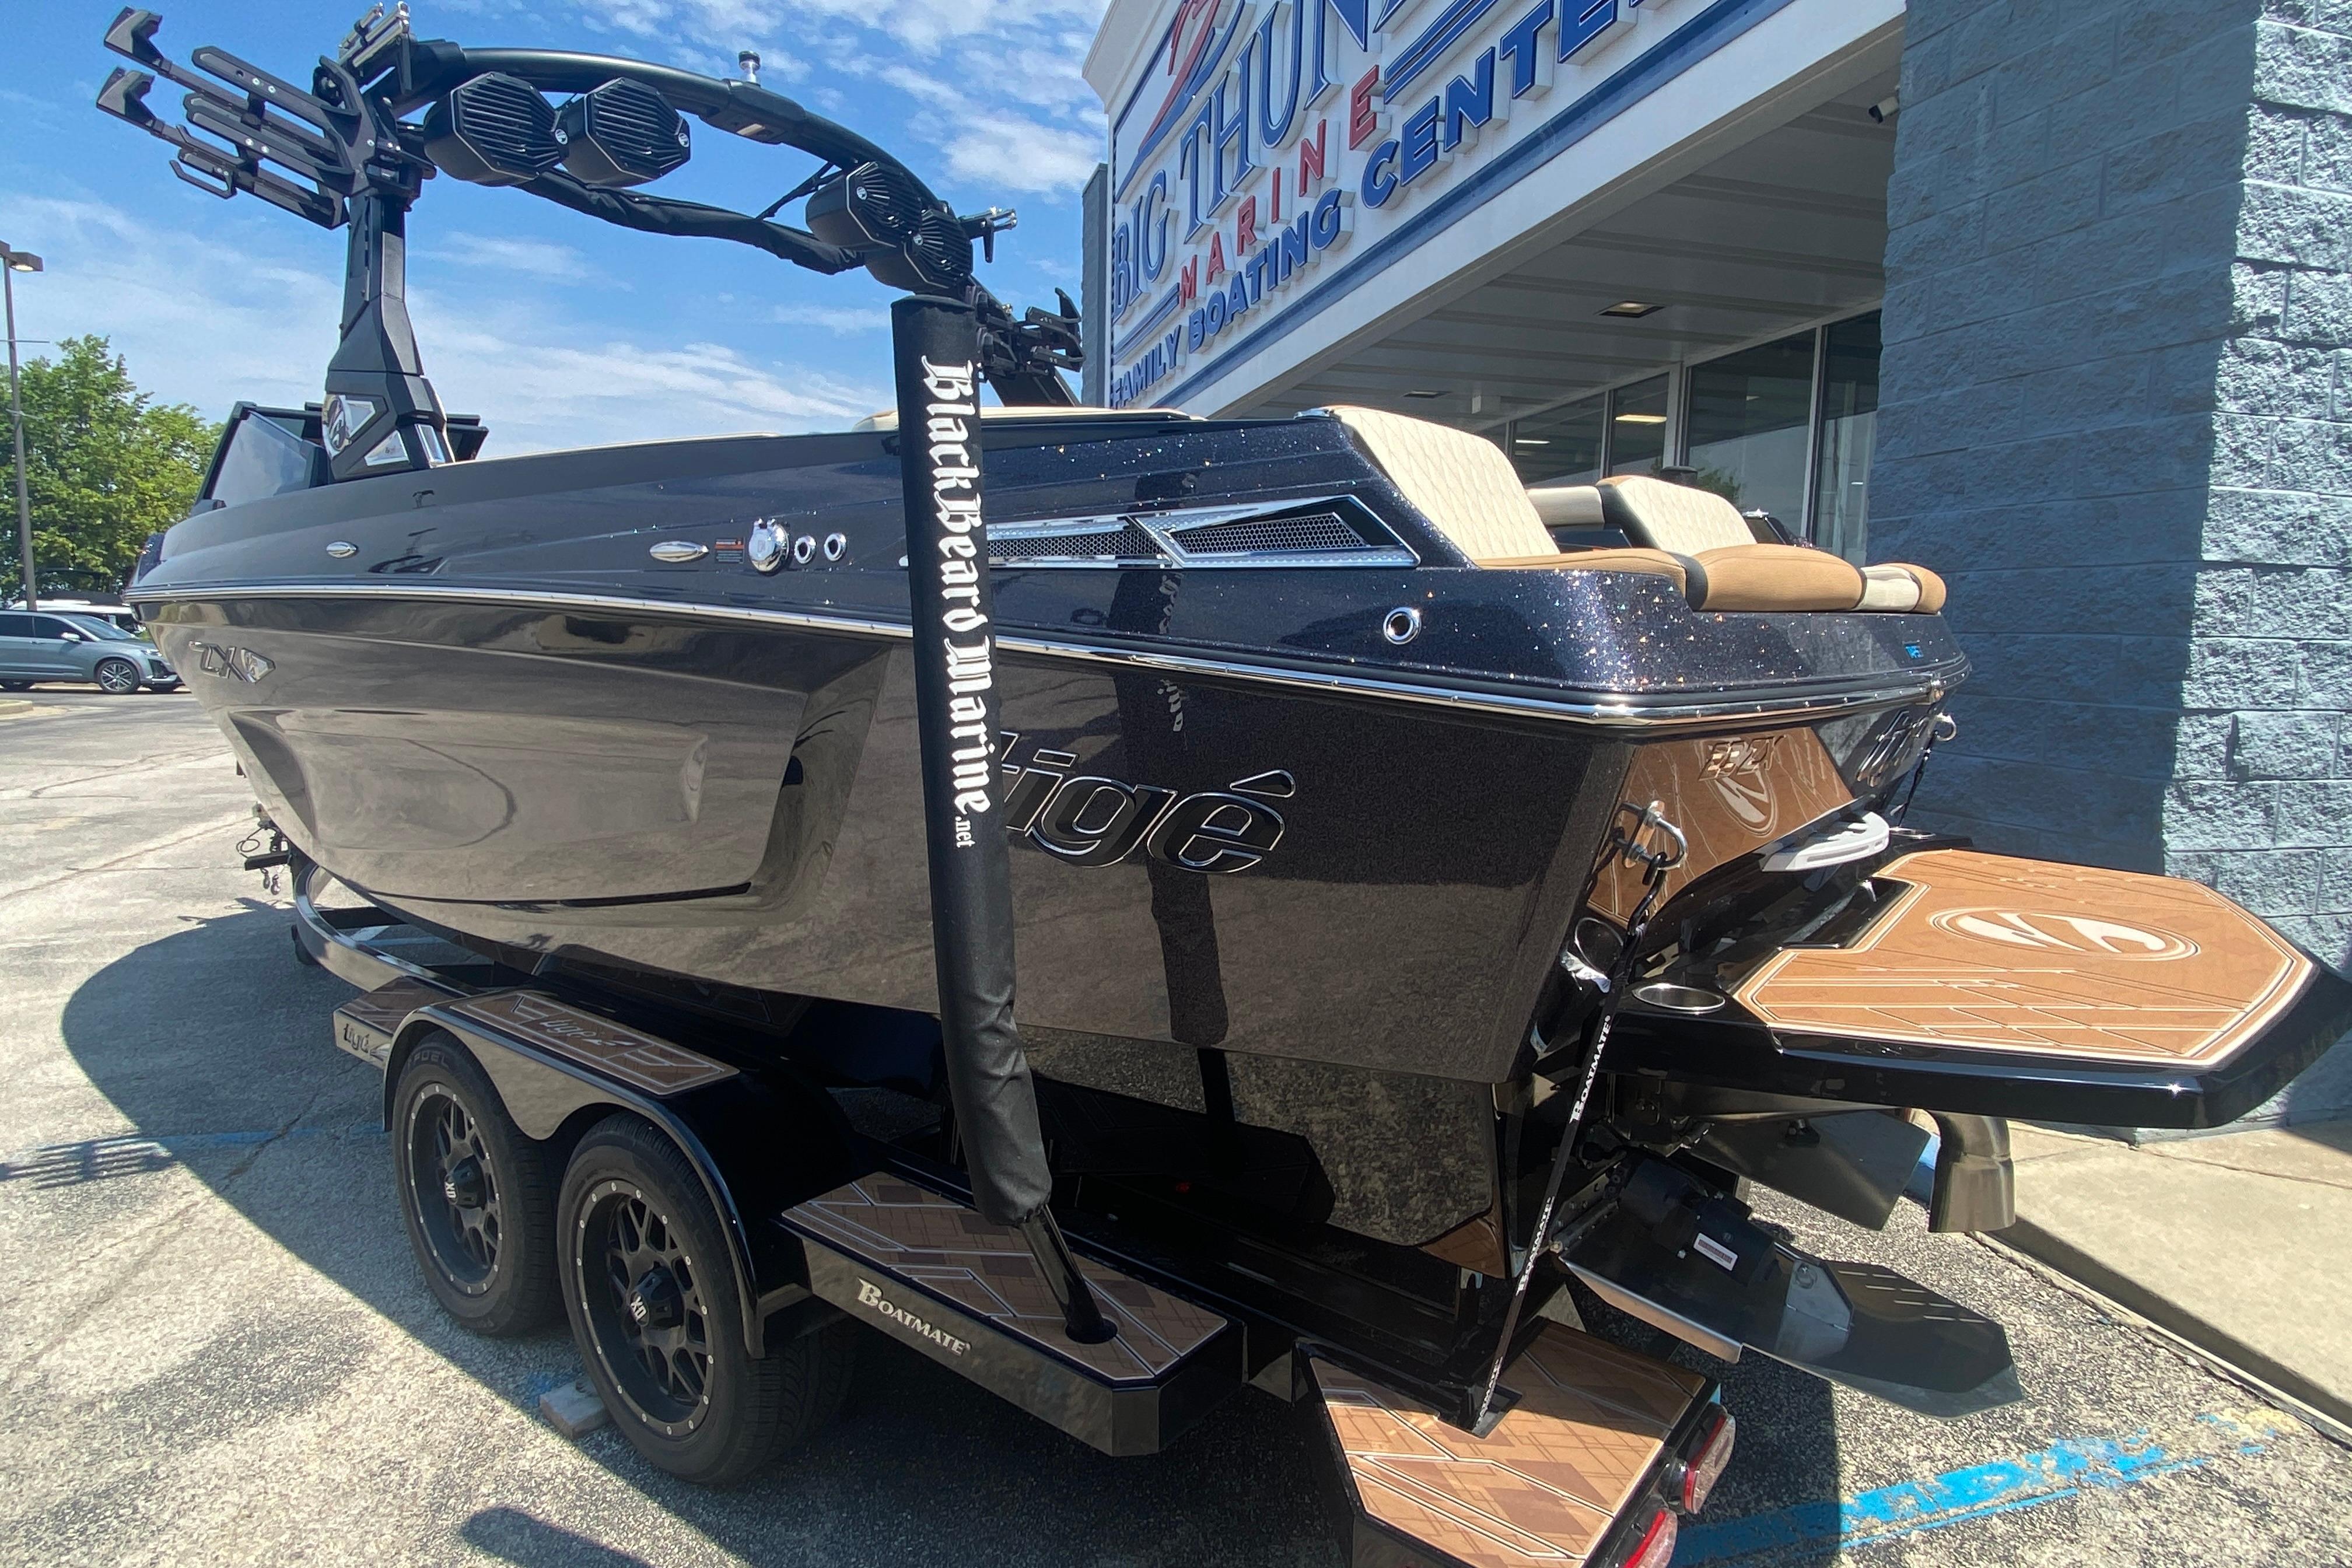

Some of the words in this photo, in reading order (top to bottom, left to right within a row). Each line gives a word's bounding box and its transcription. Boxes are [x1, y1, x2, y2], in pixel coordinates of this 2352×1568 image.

[1111, 169, 1170, 324] BIG
[1180, 64, 1380, 309] MARINE
[1111, 324, 1182, 410] FAMILY
[1188, 188, 1341, 354] BOATING
[1570, 1022, 1611, 1124] BOATMATE
[858, 1277, 965, 1357] BOATMATE
